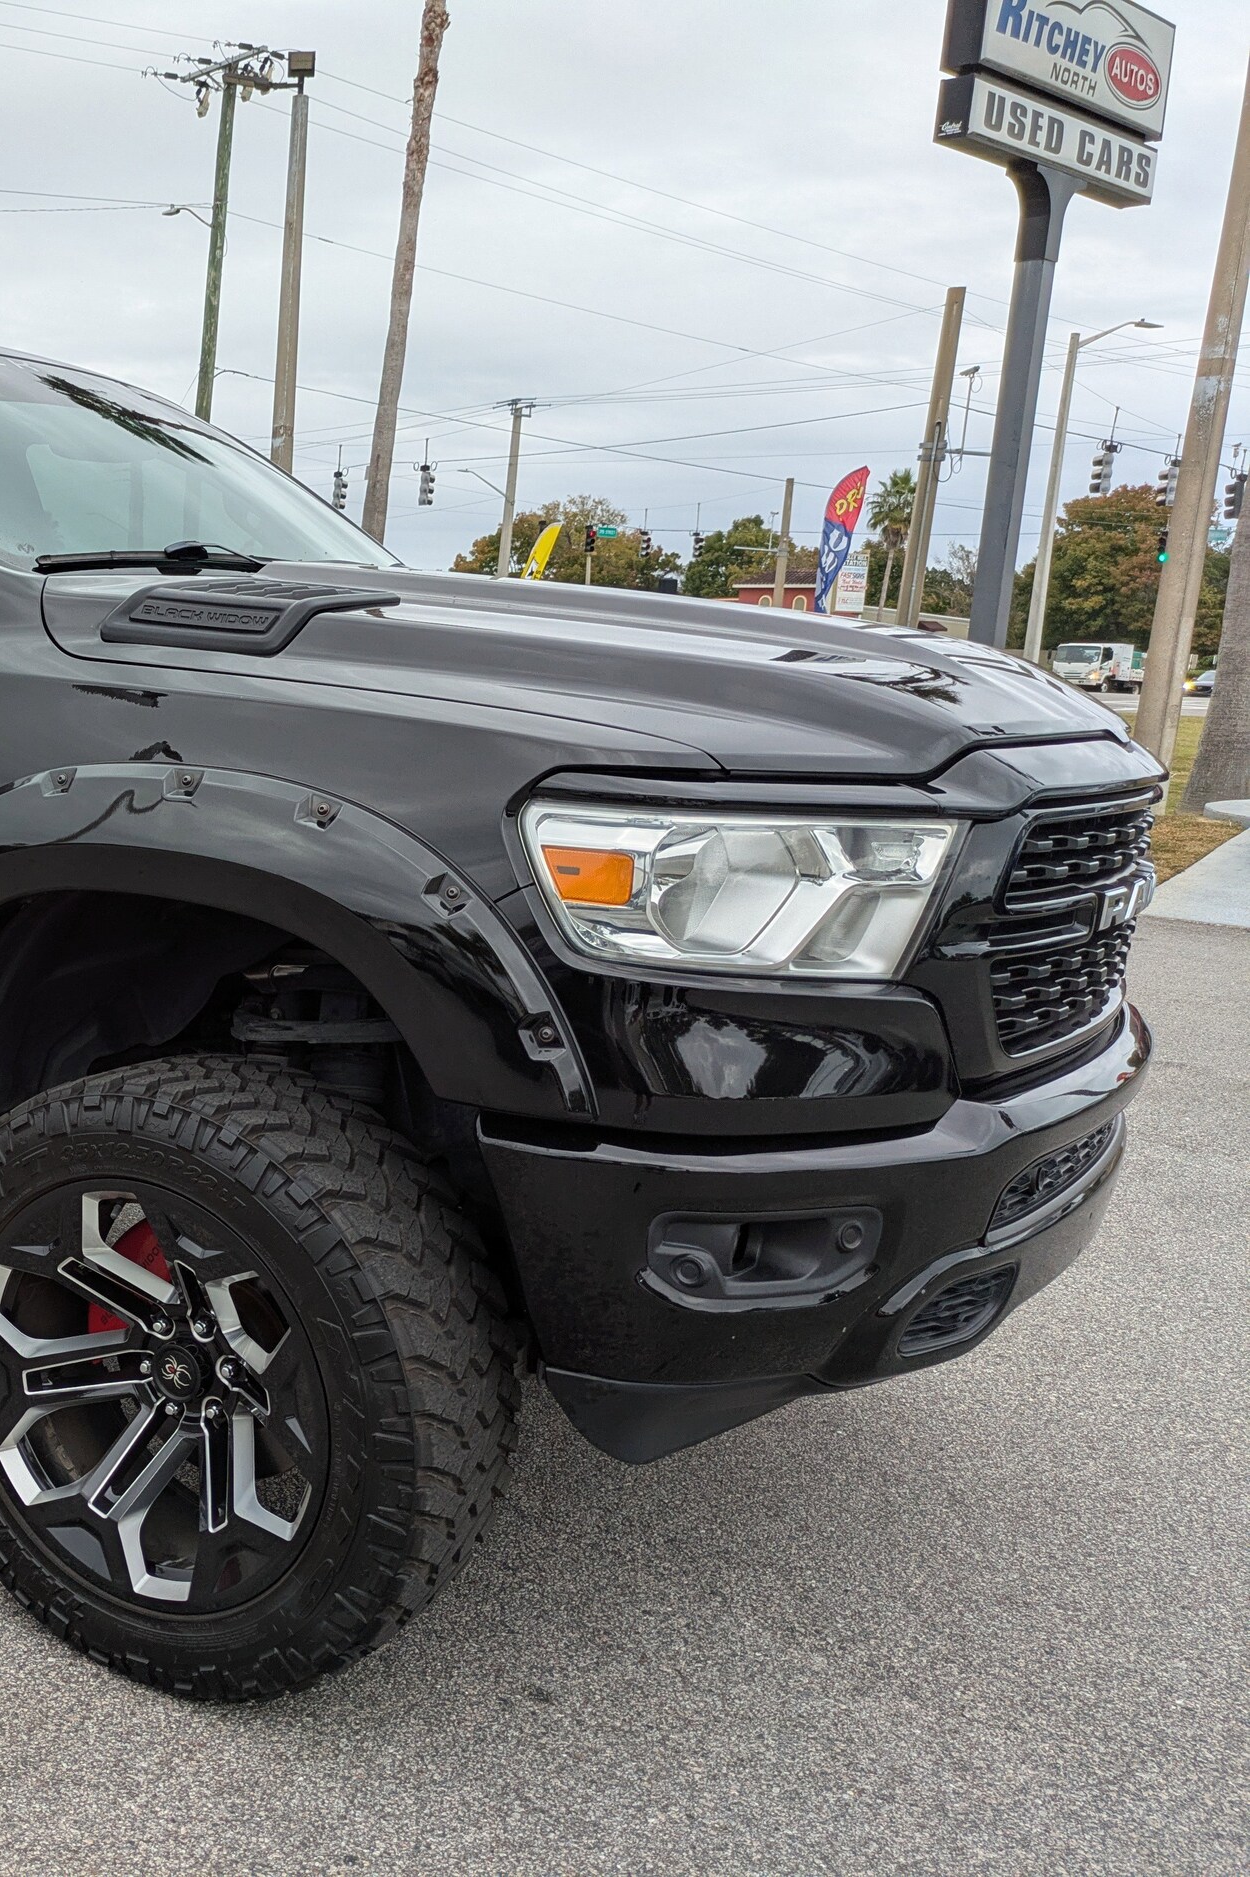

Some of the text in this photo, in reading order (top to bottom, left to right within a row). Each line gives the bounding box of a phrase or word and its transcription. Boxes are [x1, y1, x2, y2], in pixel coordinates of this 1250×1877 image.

[995, 0, 1106, 74] RITCHEY
[1050, 62, 1097, 97] NORTH
[1111, 57, 1157, 96] AUTOS
[983, 91, 1151, 189] USED CARS
[141, 604, 270, 626] BLACK WIDOW
